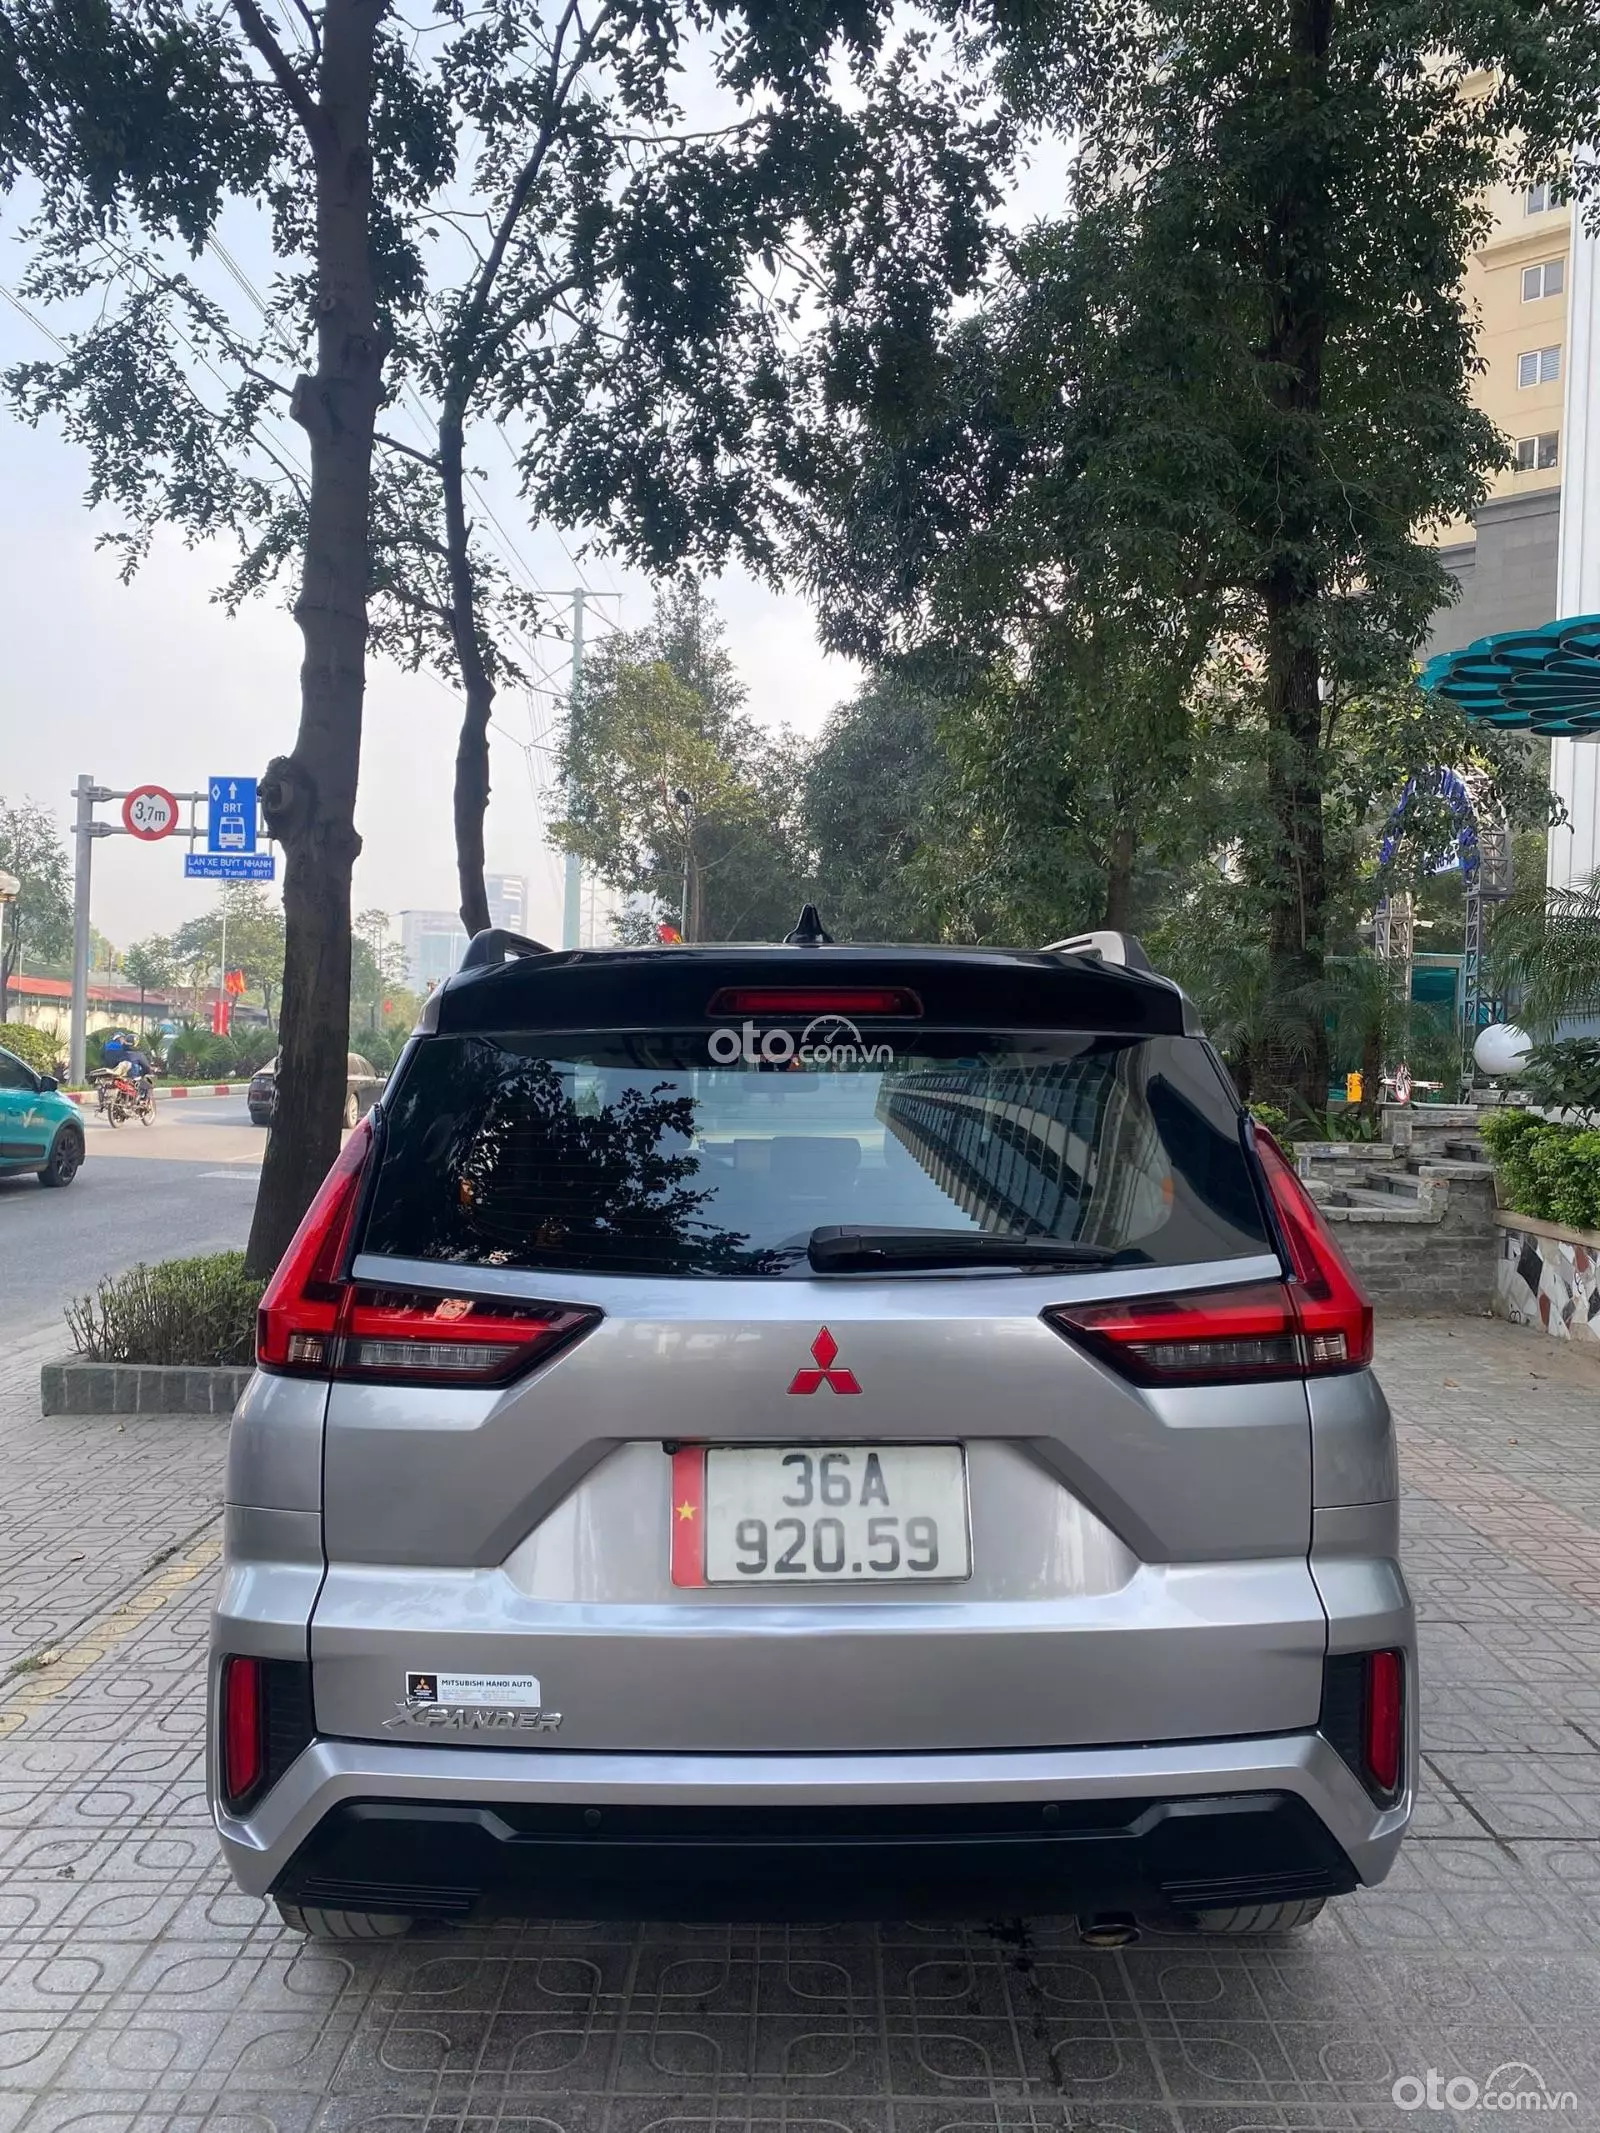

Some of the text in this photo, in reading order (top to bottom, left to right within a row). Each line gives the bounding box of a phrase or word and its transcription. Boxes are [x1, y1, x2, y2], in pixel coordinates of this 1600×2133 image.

[135, 802, 166, 823] 3,7m
[223, 802, 243, 813] BRT
[207, 858, 219, 866] XE
[243, 860, 272, 868] NHANH
[188, 867, 272, 877] Bus Rapid Transit (BRT)
[782, 1453, 890, 1507] 36A
[735, 1516, 939, 1574] 920.59
[486, 1680, 510, 1688] HANOI
[382, 1696, 563, 1733] XPANDER
